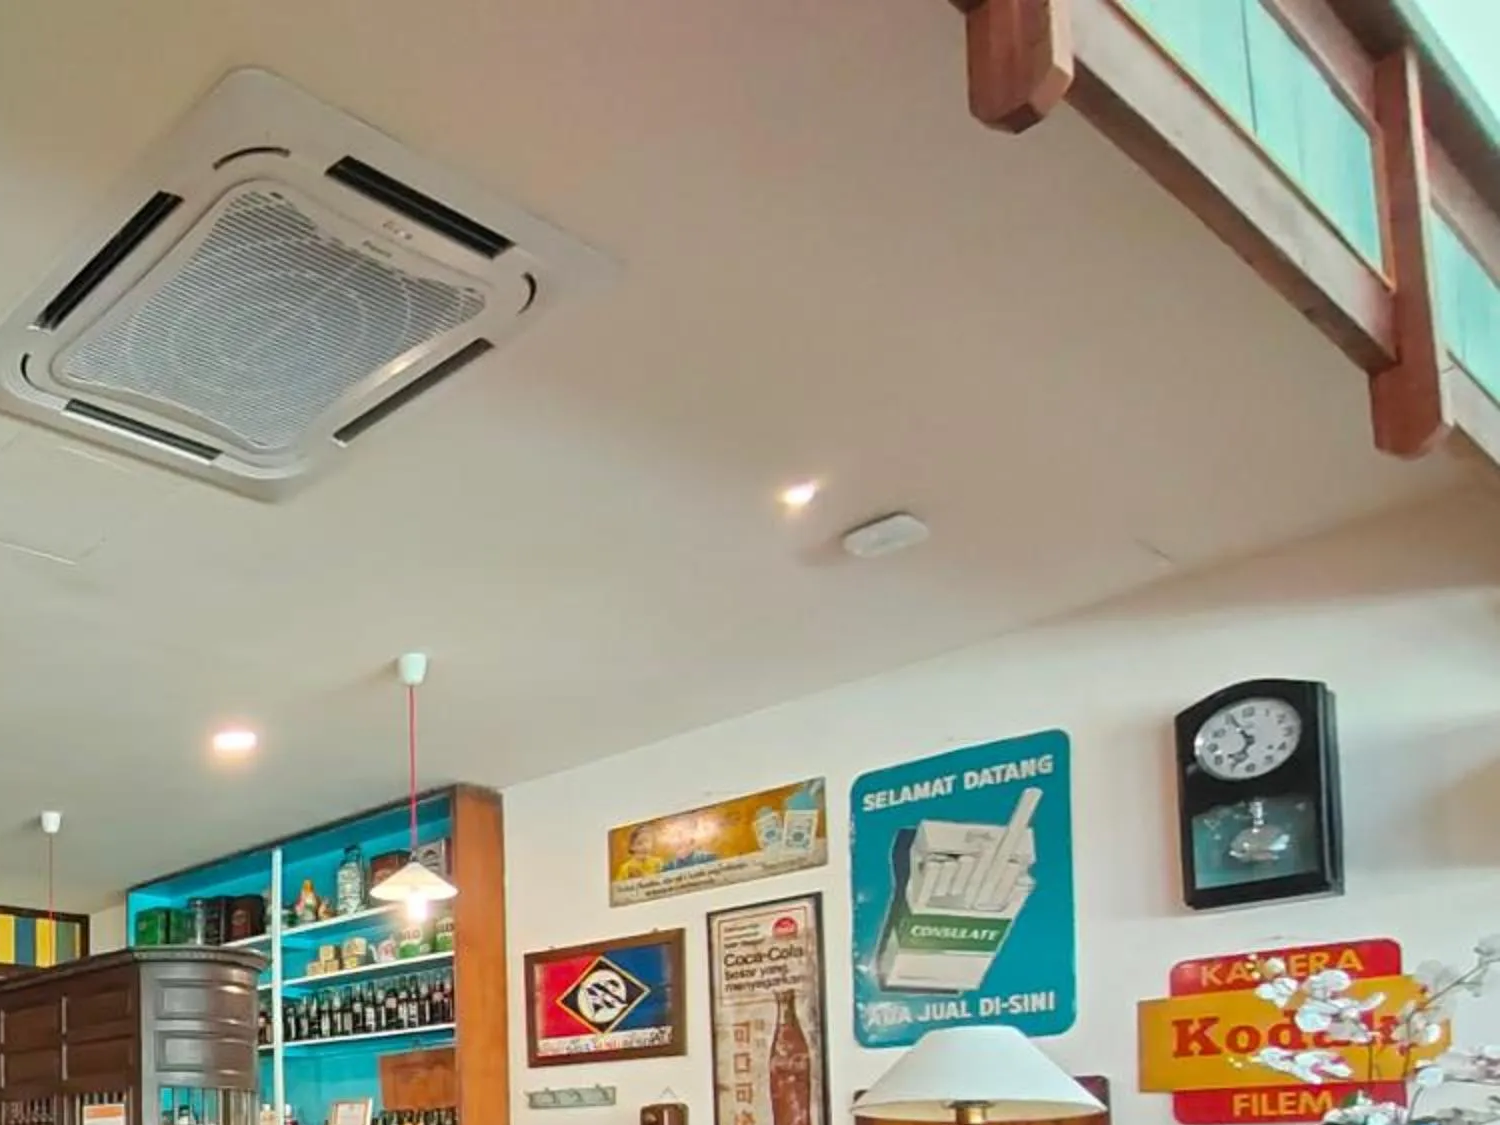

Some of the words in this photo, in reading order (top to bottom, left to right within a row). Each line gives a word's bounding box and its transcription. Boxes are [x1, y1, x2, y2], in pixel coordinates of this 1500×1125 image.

[862, 775, 957, 812] SELAMAT
[963, 754, 1054, 791] DATANG
[723, 943, 804, 968] Coca-Cola
[1201, 948, 1365, 988] KAERA
[917, 1000, 973, 1022] JUAL
[979, 990, 1056, 1017] DI-SINI
[1232, 1090, 1333, 1118] FILEM
